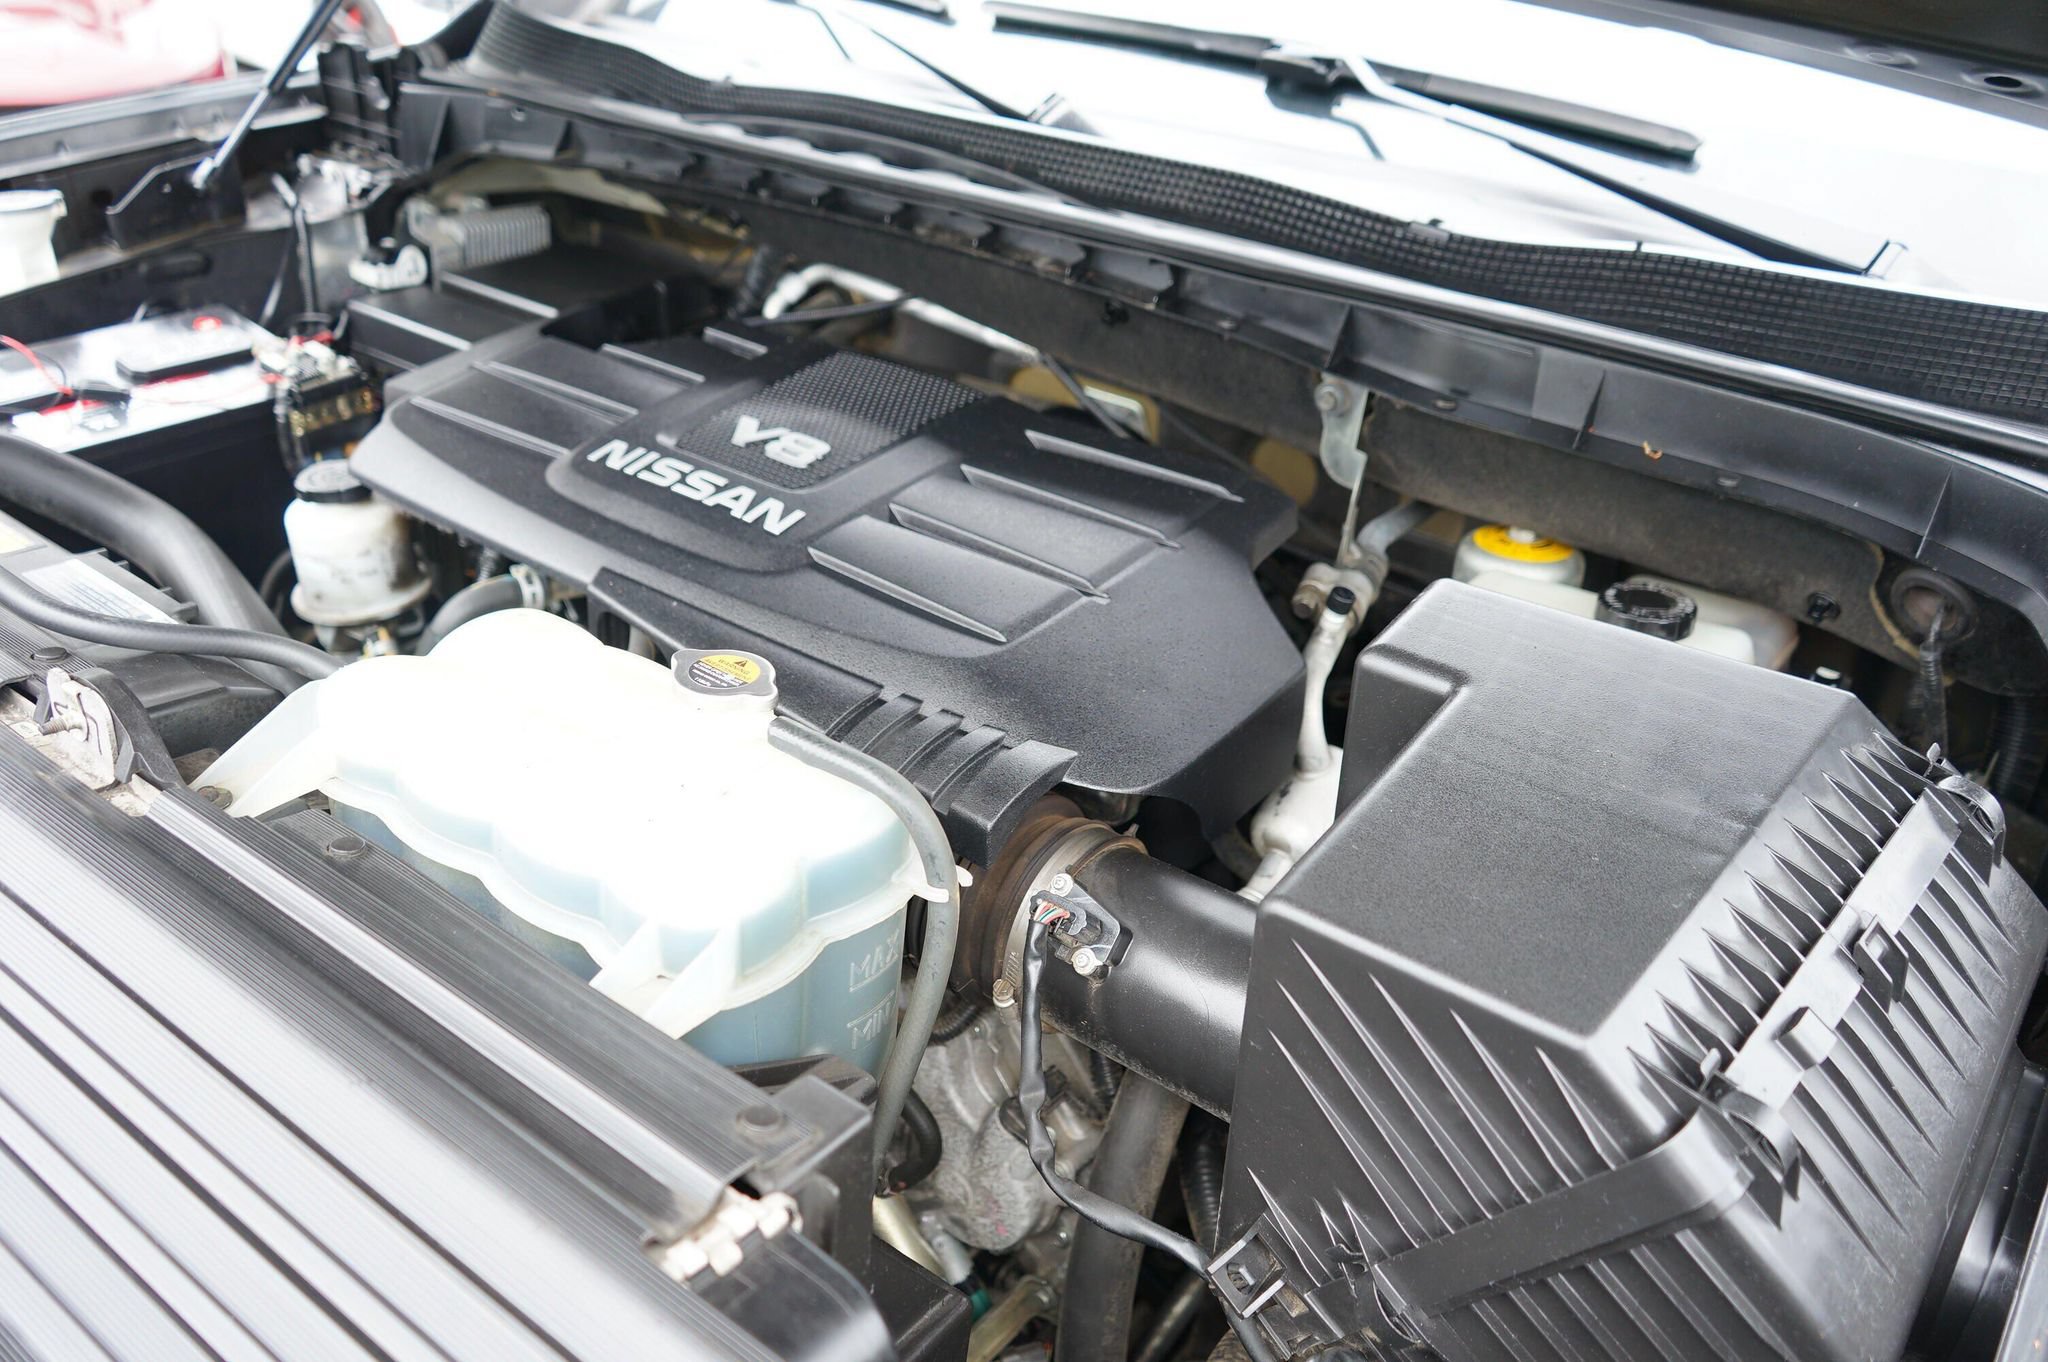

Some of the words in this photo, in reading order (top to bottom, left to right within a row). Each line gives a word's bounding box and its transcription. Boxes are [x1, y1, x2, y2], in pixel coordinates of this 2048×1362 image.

[731, 415, 831, 468] V8
[587, 439, 806, 536] NISSAN
[850, 928, 899, 986] MAX
[852, 1000, 896, 1049] MIN
